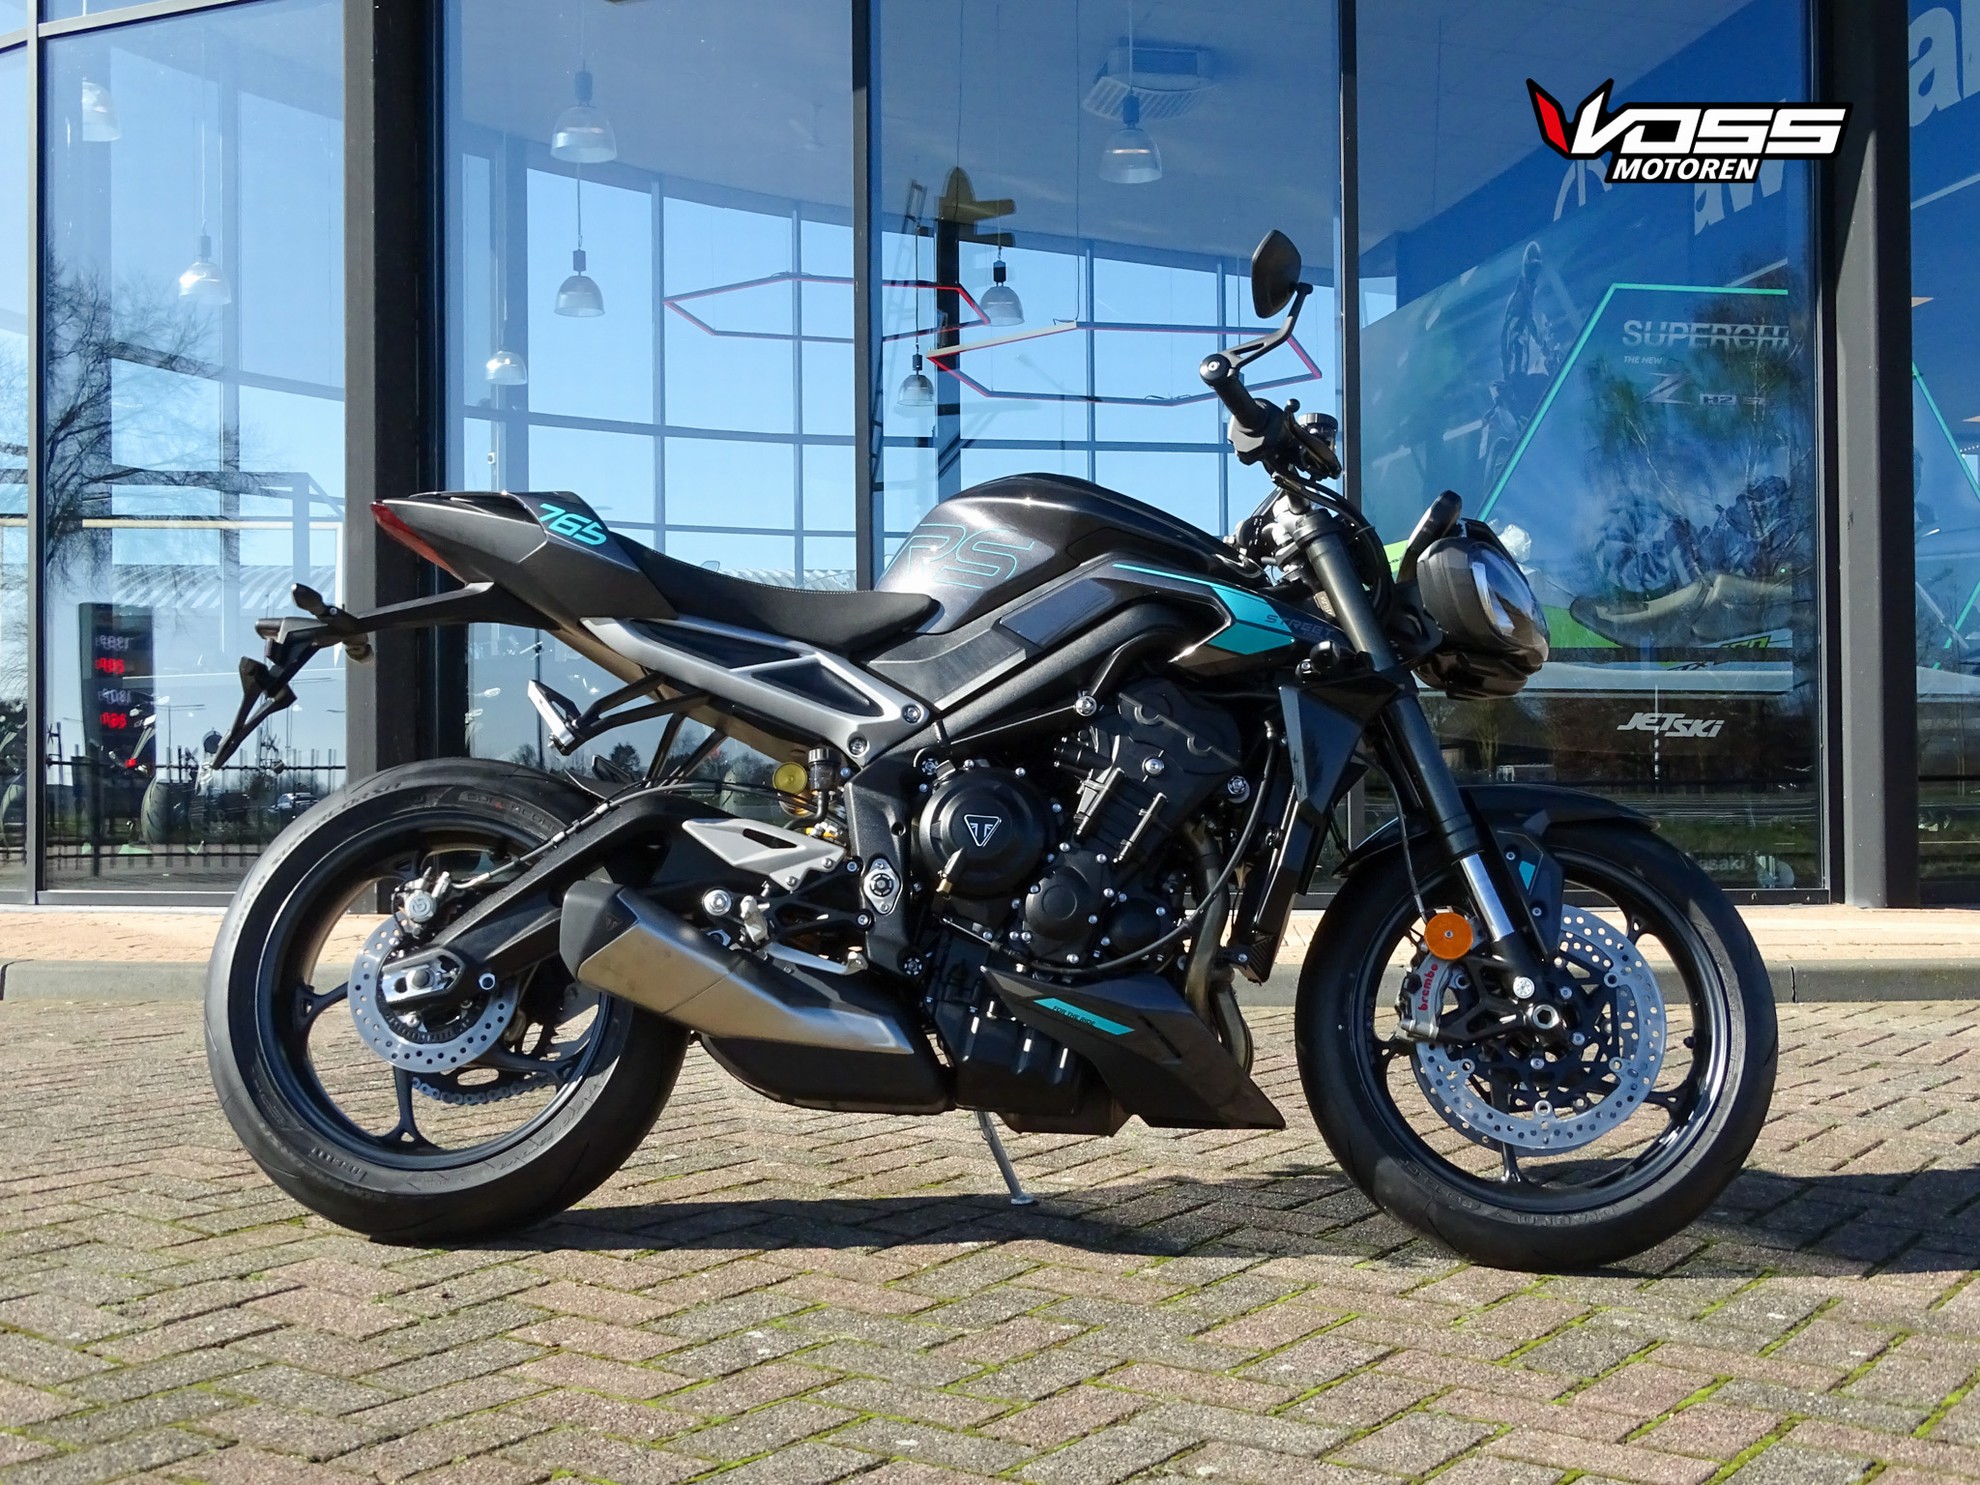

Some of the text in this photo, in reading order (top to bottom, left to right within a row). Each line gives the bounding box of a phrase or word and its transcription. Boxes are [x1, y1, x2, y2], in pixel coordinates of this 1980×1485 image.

[1623, 355, 1640, 364] THE
[540, 503, 608, 546] 765
[882, 522, 1036, 590] RS
[1265, 614, 1335, 636] STREET
[1417, 963, 1439, 1012] brembo
[1052, 1005, 1067, 1016] FOR
[1067, 1010, 1080, 1021] THE
